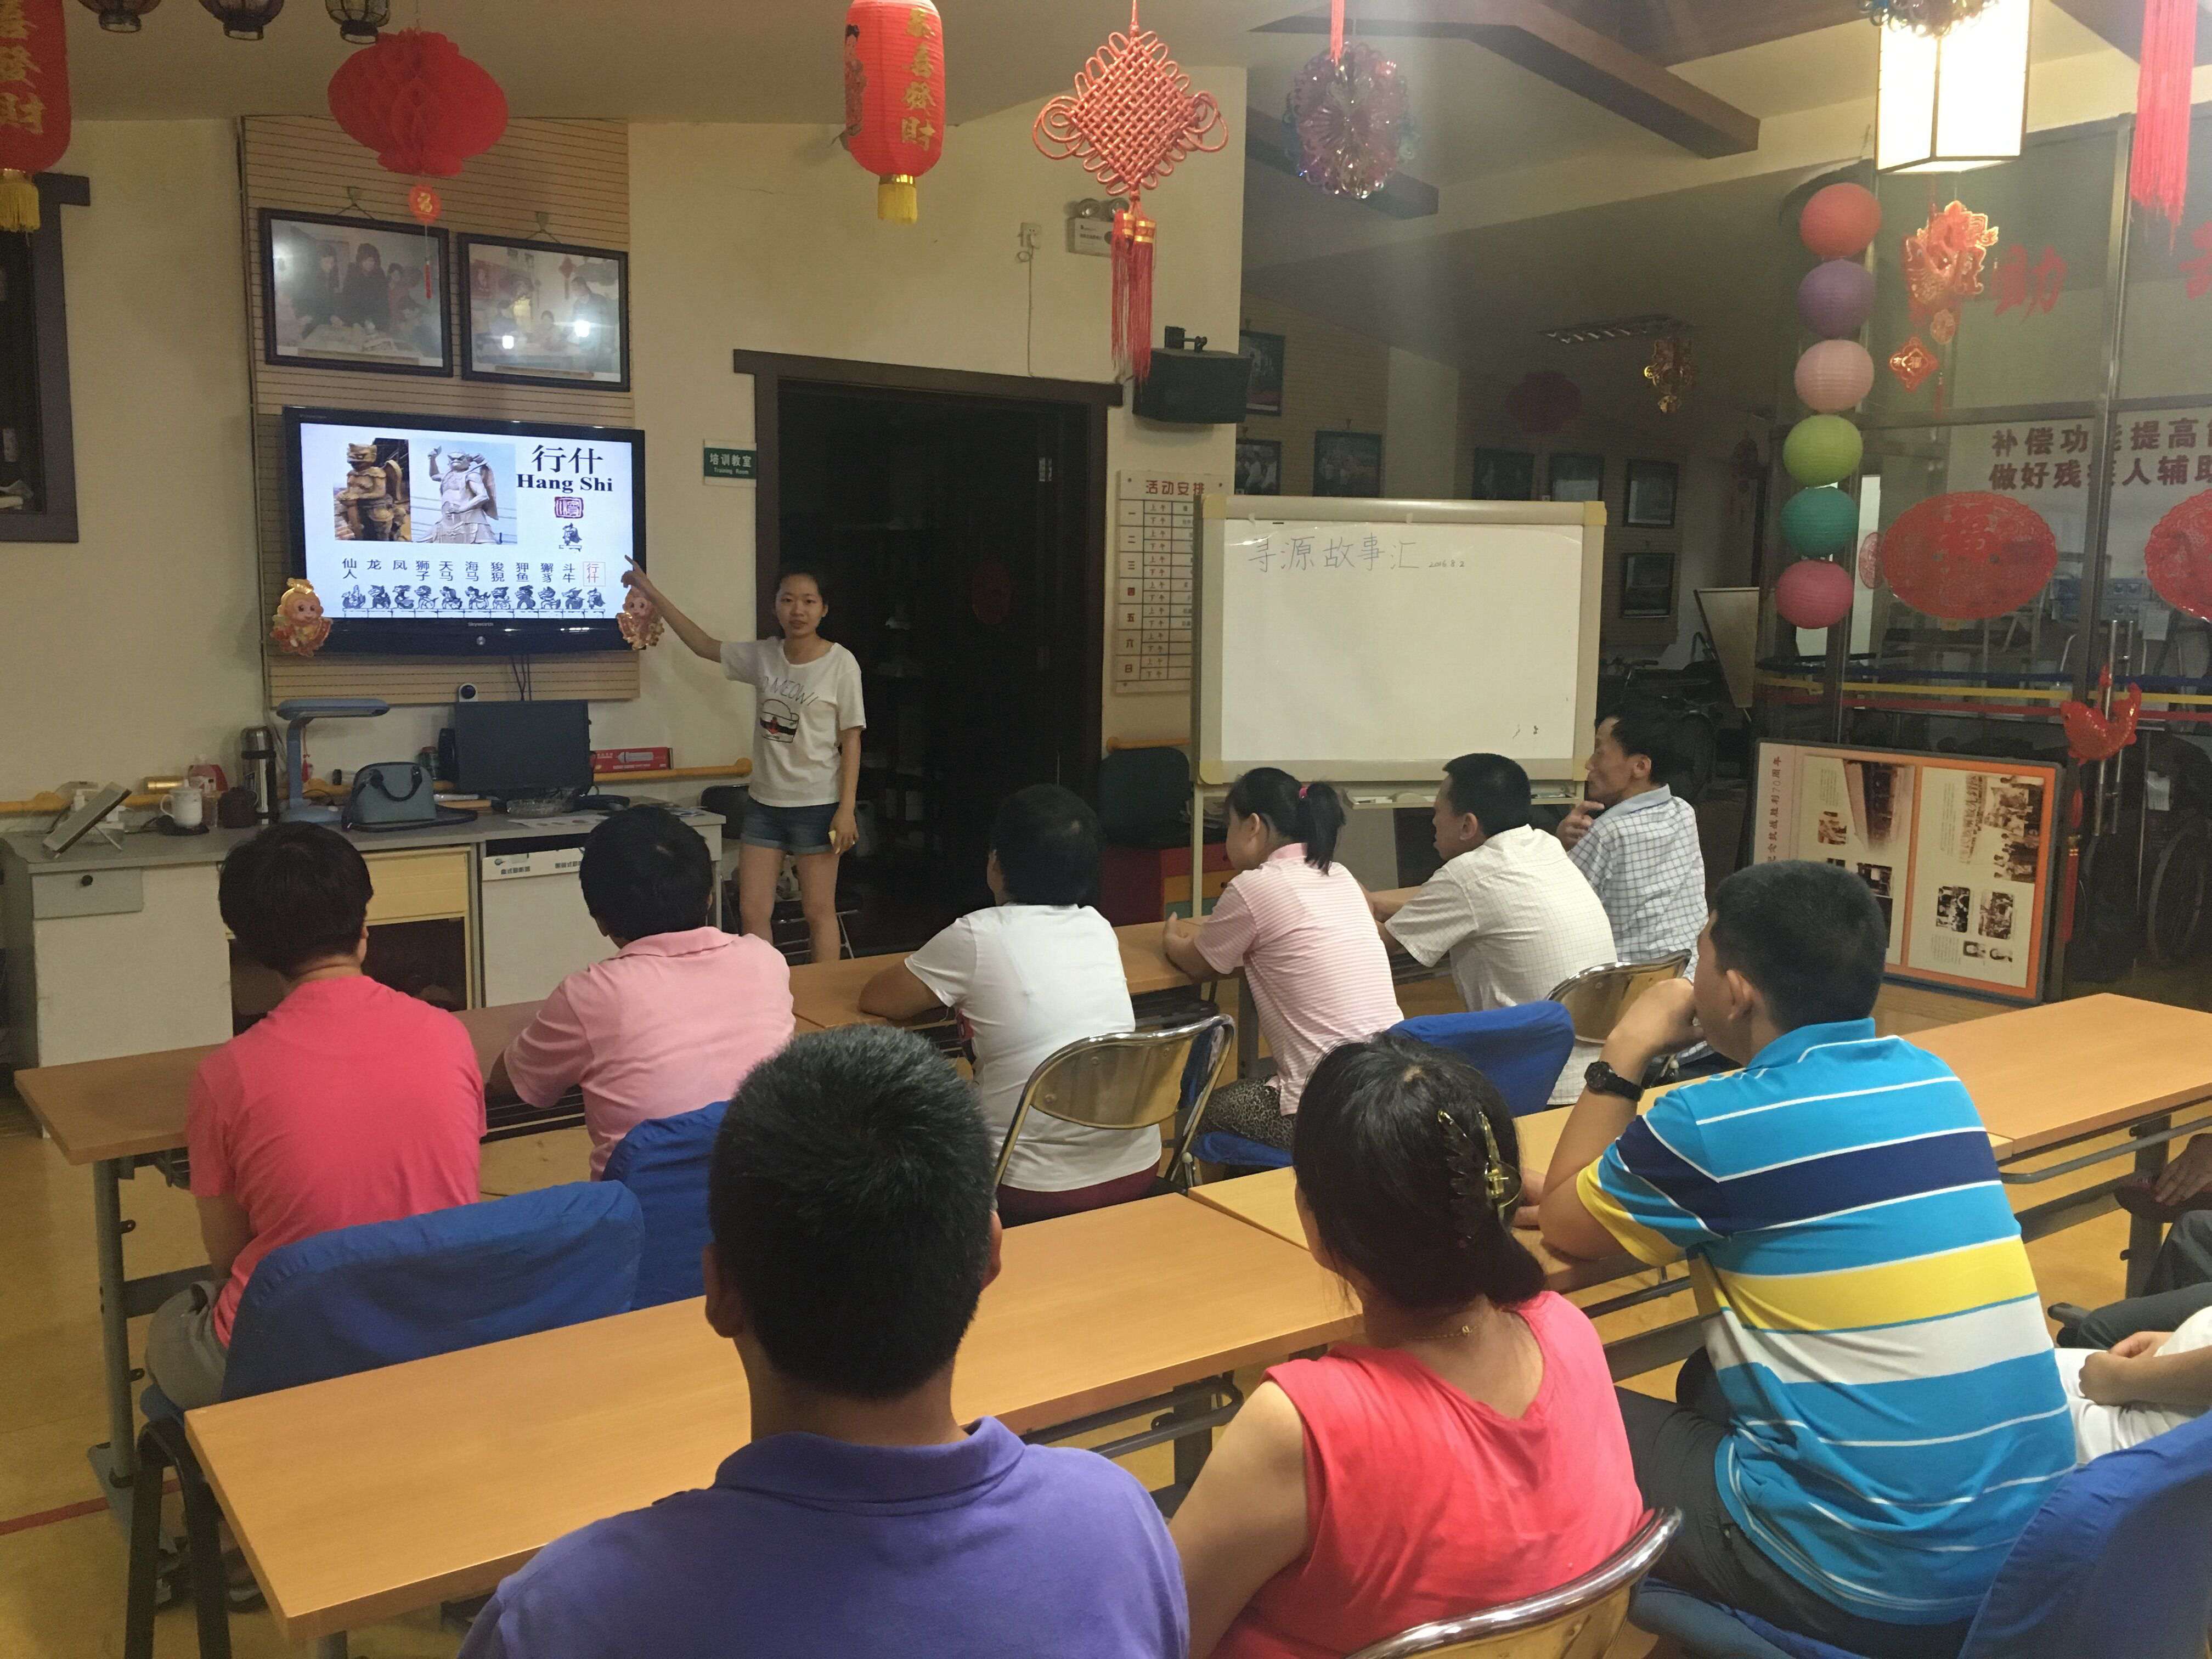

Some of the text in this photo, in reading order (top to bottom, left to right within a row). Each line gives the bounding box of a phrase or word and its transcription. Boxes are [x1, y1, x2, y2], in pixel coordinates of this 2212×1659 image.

[1991, 417, 2212, 457] 补偿功提高
[531, 444, 604, 475] 行什
[709, 453, 752, 467] 培训教室
[516, 474, 613, 494] Hang Shi
[1145, 479, 1205, 496] 活动安排
[1127, 535, 1136, 544] 二
[1248, 532, 1419, 573] 寻源故事汇
[342, 558, 357, 579] 仙人
[366, 559, 382, 571] 龙
[393, 560, 408, 571] 凤
[415, 560, 430, 582] 狮子
[439, 561, 453, 582] 天马
[465, 561, 479, 582] 海马
[562, 563, 575, 583] 斗牛
[586, 563, 600, 583] 行什
[1127, 560, 1136, 570] 三
[1127, 613, 1136, 622] 五
